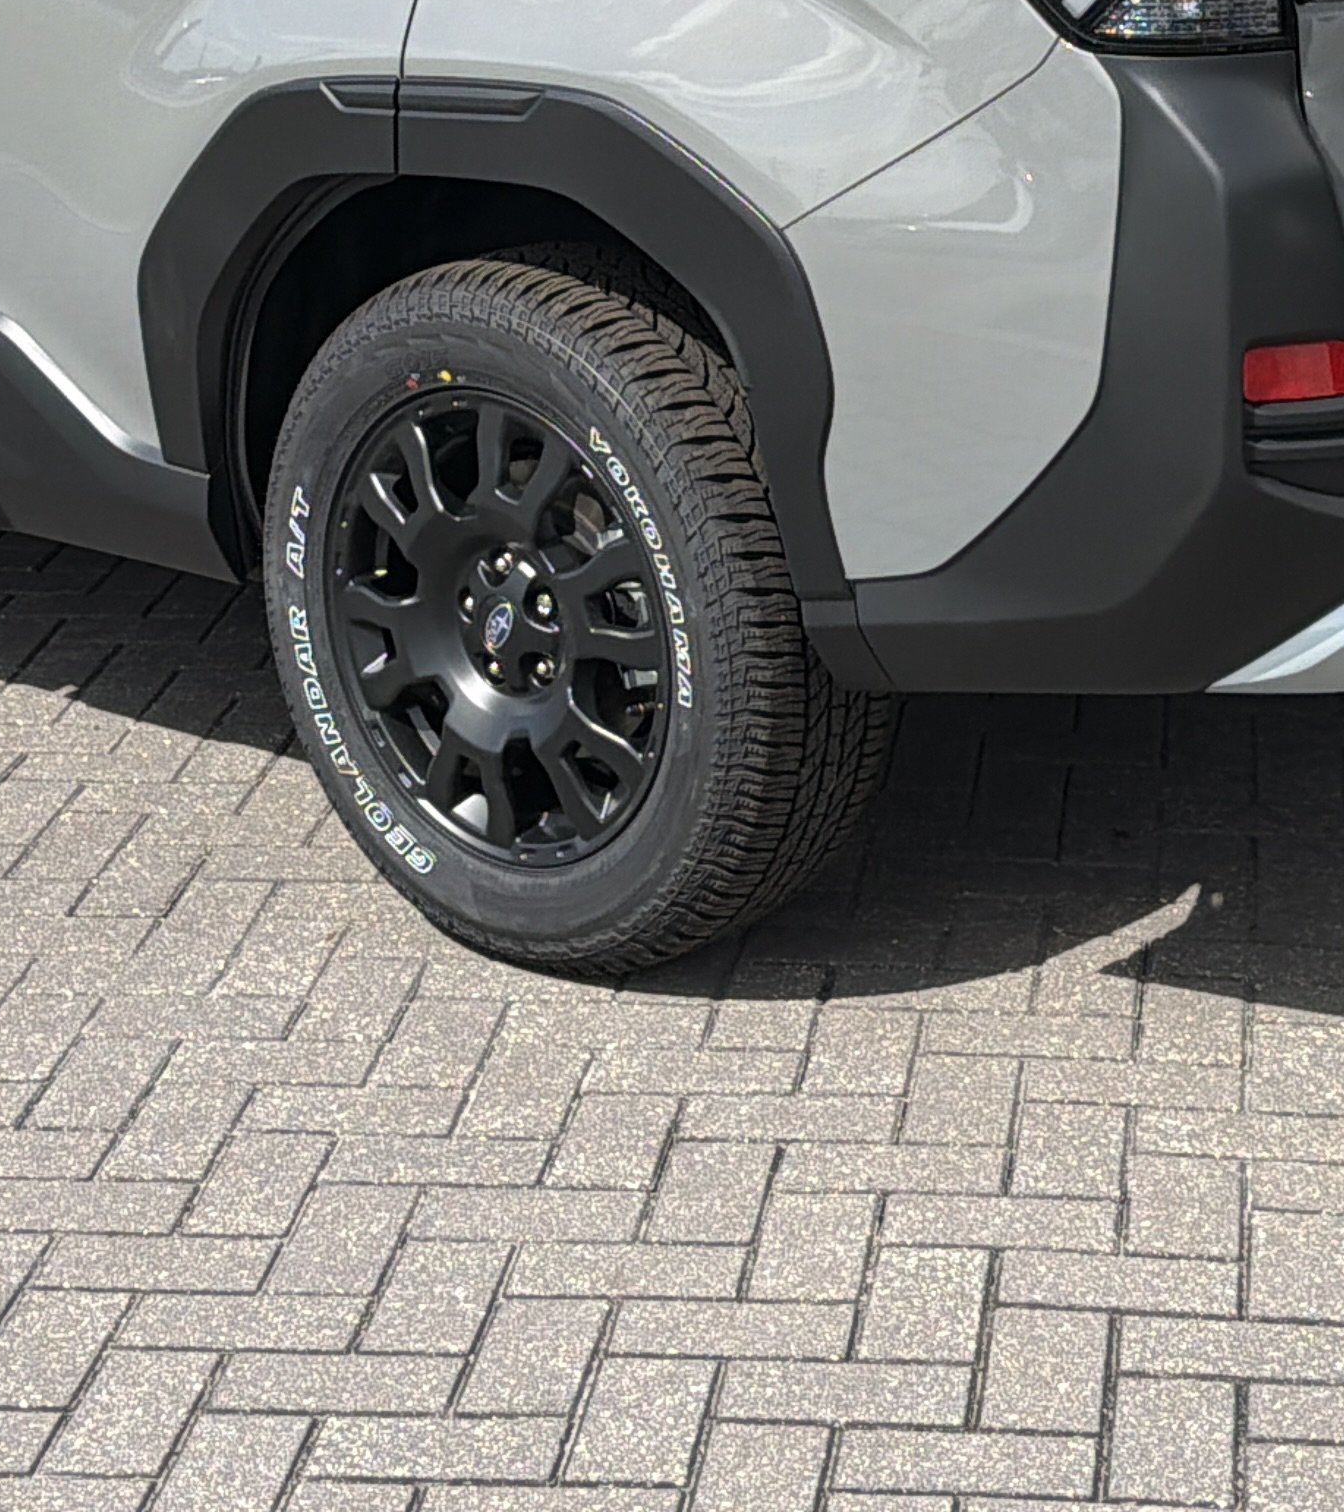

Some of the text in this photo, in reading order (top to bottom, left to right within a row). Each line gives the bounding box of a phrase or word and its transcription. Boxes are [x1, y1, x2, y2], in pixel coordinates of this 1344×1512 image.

[286, 486, 439, 875] GEOLANDAR A/T
[589, 426, 692, 708] YOKOHAMA
